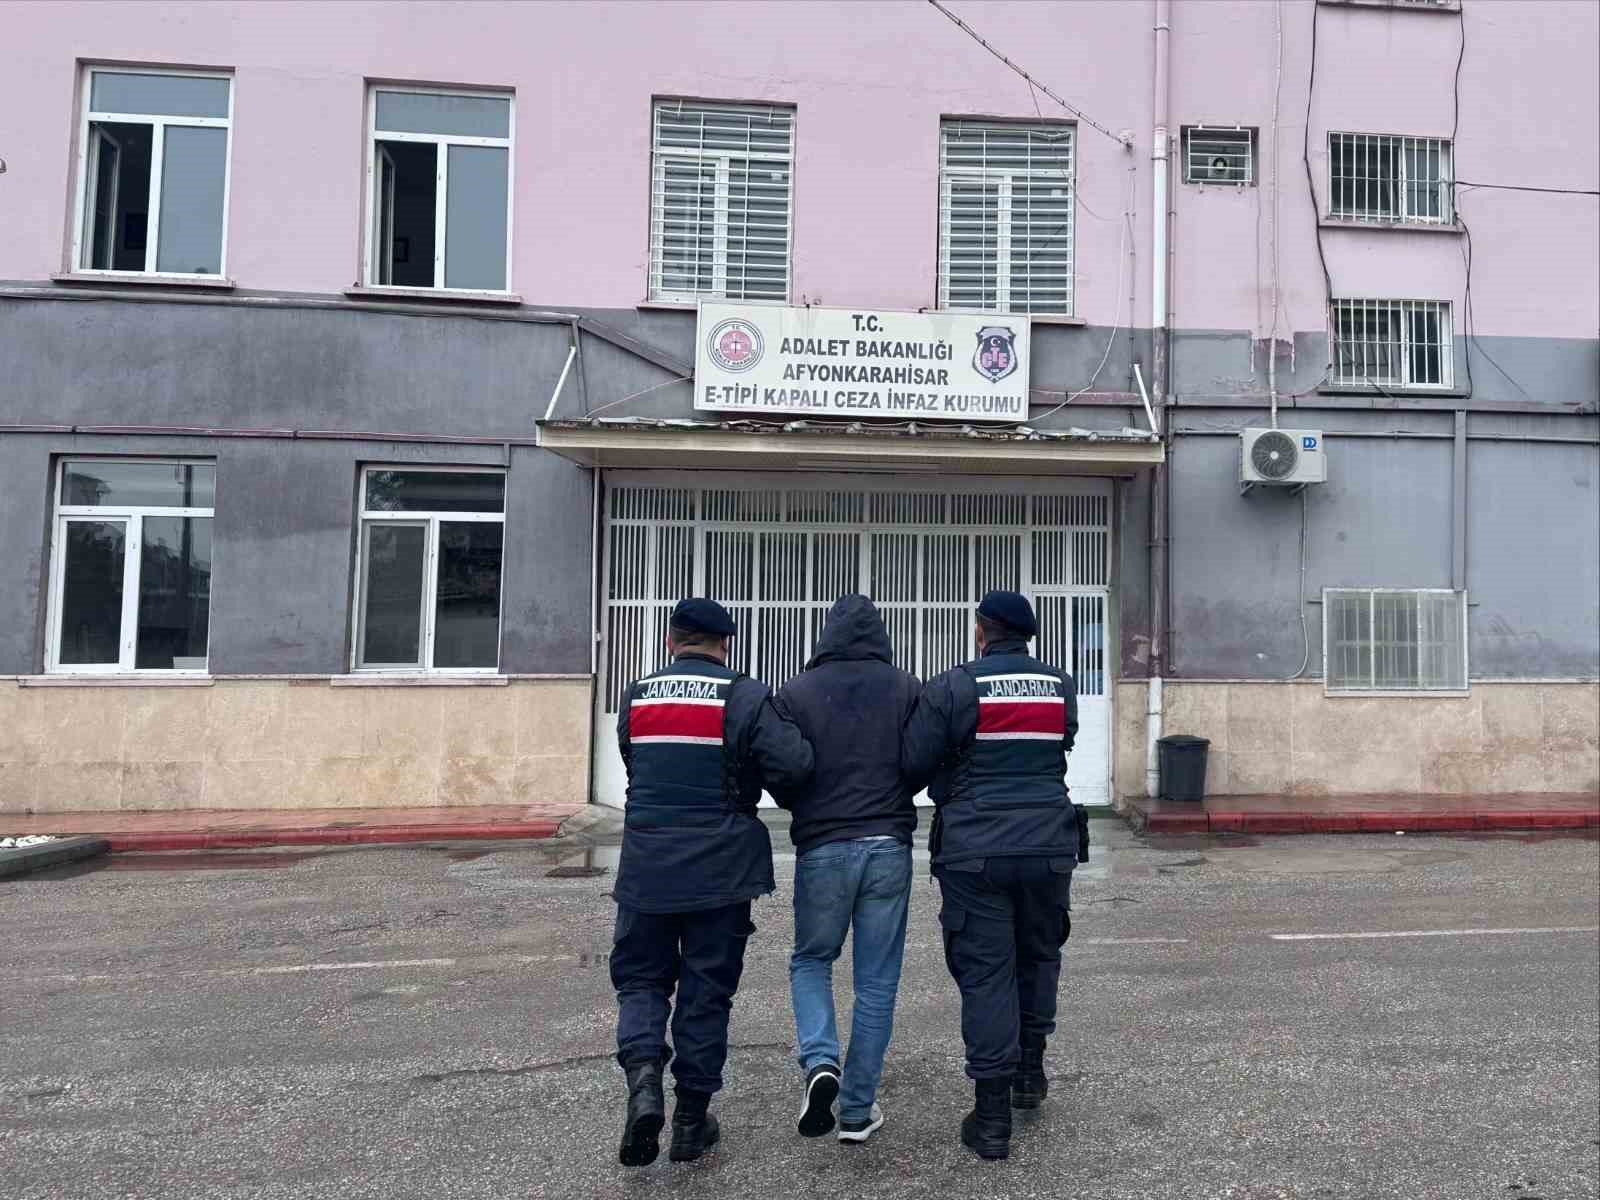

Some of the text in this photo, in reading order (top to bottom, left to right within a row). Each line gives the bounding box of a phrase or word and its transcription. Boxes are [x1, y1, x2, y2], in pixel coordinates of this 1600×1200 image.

[852, 314, 884, 332] T.C.
[779, 337, 850, 357] ADALET
[856, 339, 953, 361] BAKANLIĞI
[783, 362, 949, 386] AFYONKARAHİSAR
[705, 384, 1022, 414] E-TİPİ KAPALI CEZA İNFAZ KURUMU
[641, 680, 719, 700] JANDARMA
[986, 679, 1058, 698] JANDARMA
